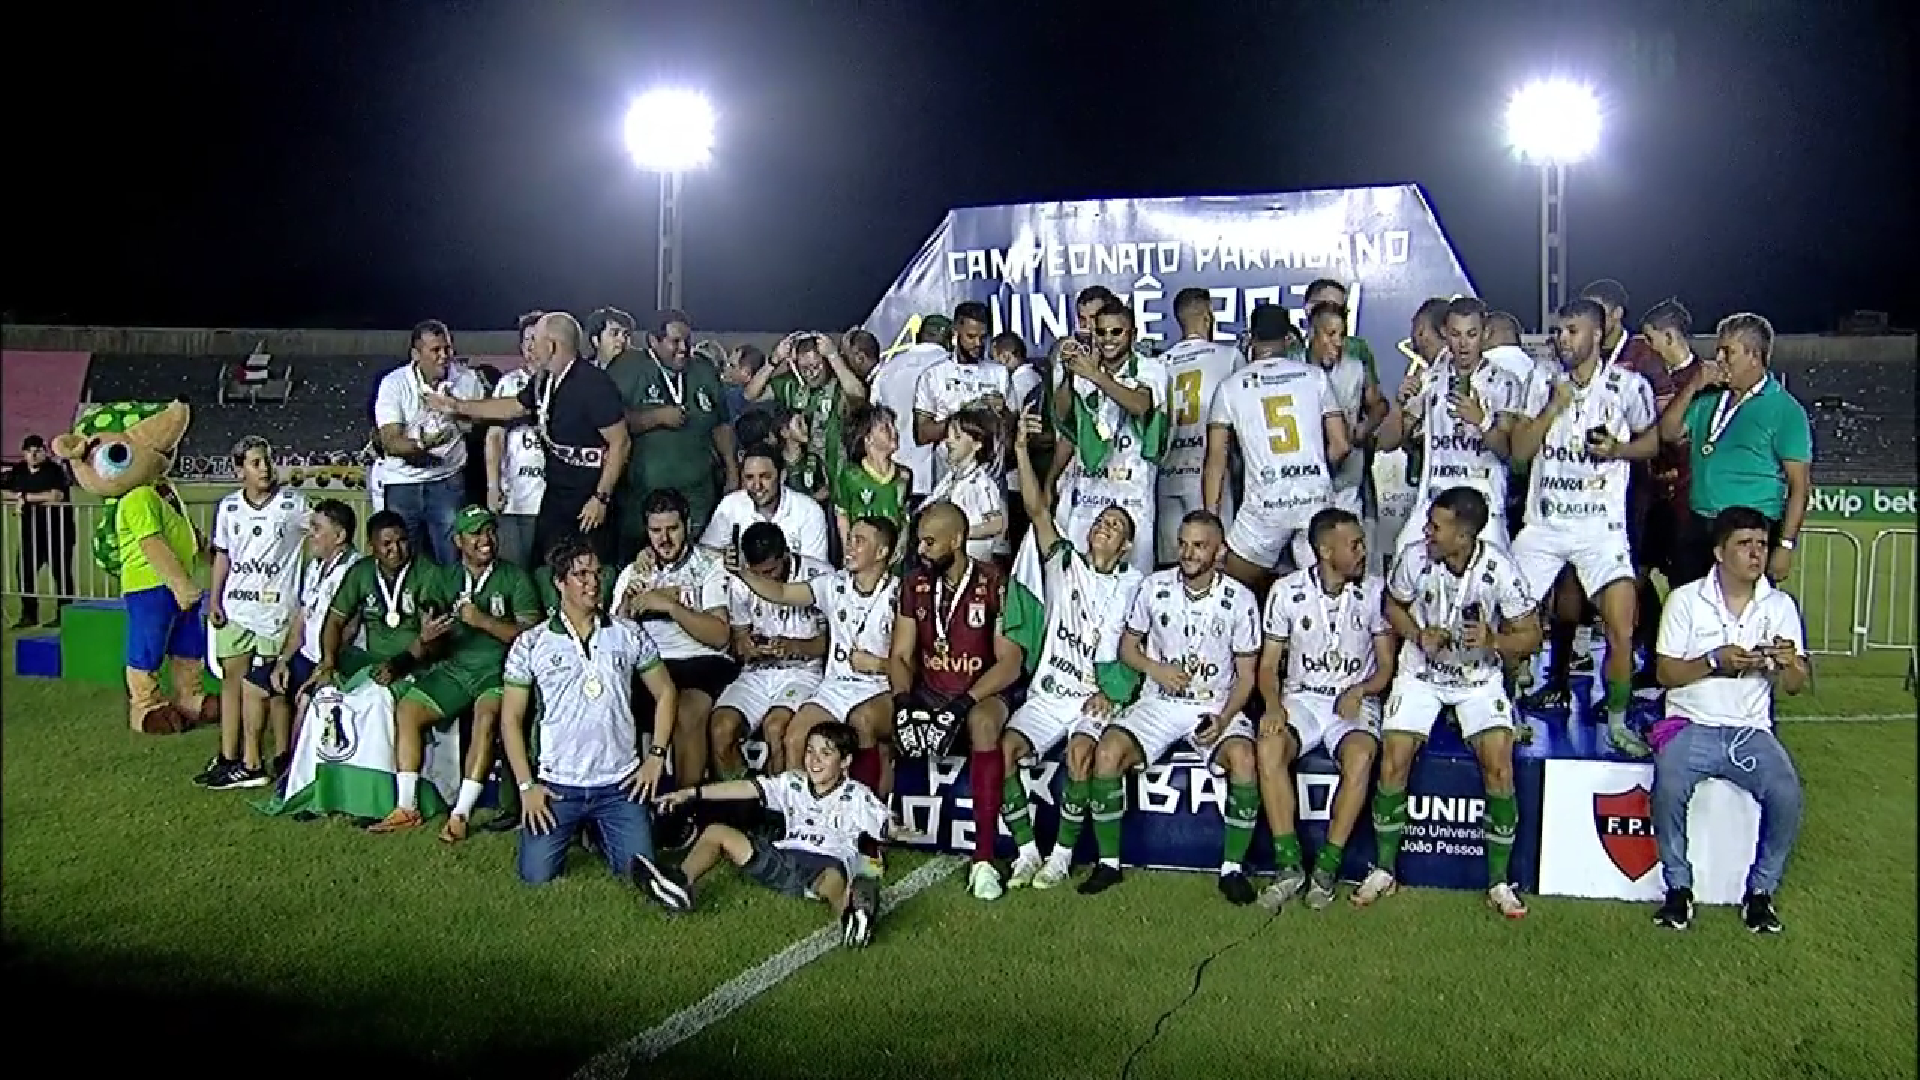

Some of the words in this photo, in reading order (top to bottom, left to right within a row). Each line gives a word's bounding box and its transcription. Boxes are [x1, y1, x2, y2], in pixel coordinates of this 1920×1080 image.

[948, 241, 1180, 284] CAMPEONATO
[1261, 394, 1301, 455] 5
[1280, 465, 1321, 479] SOUSA
[1556, 502, 1607, 515] CAGEPA
[1807, 488, 1863, 518] tvip
[1056, 618, 1097, 661] betvi
[923, 650, 984, 676] betvip
[1407, 795, 1486, 823] UNIP
[1431, 824, 1485, 839] Universit
[1401, 839, 1433, 853] João
[1437, 841, 1484, 856] Pessoa
